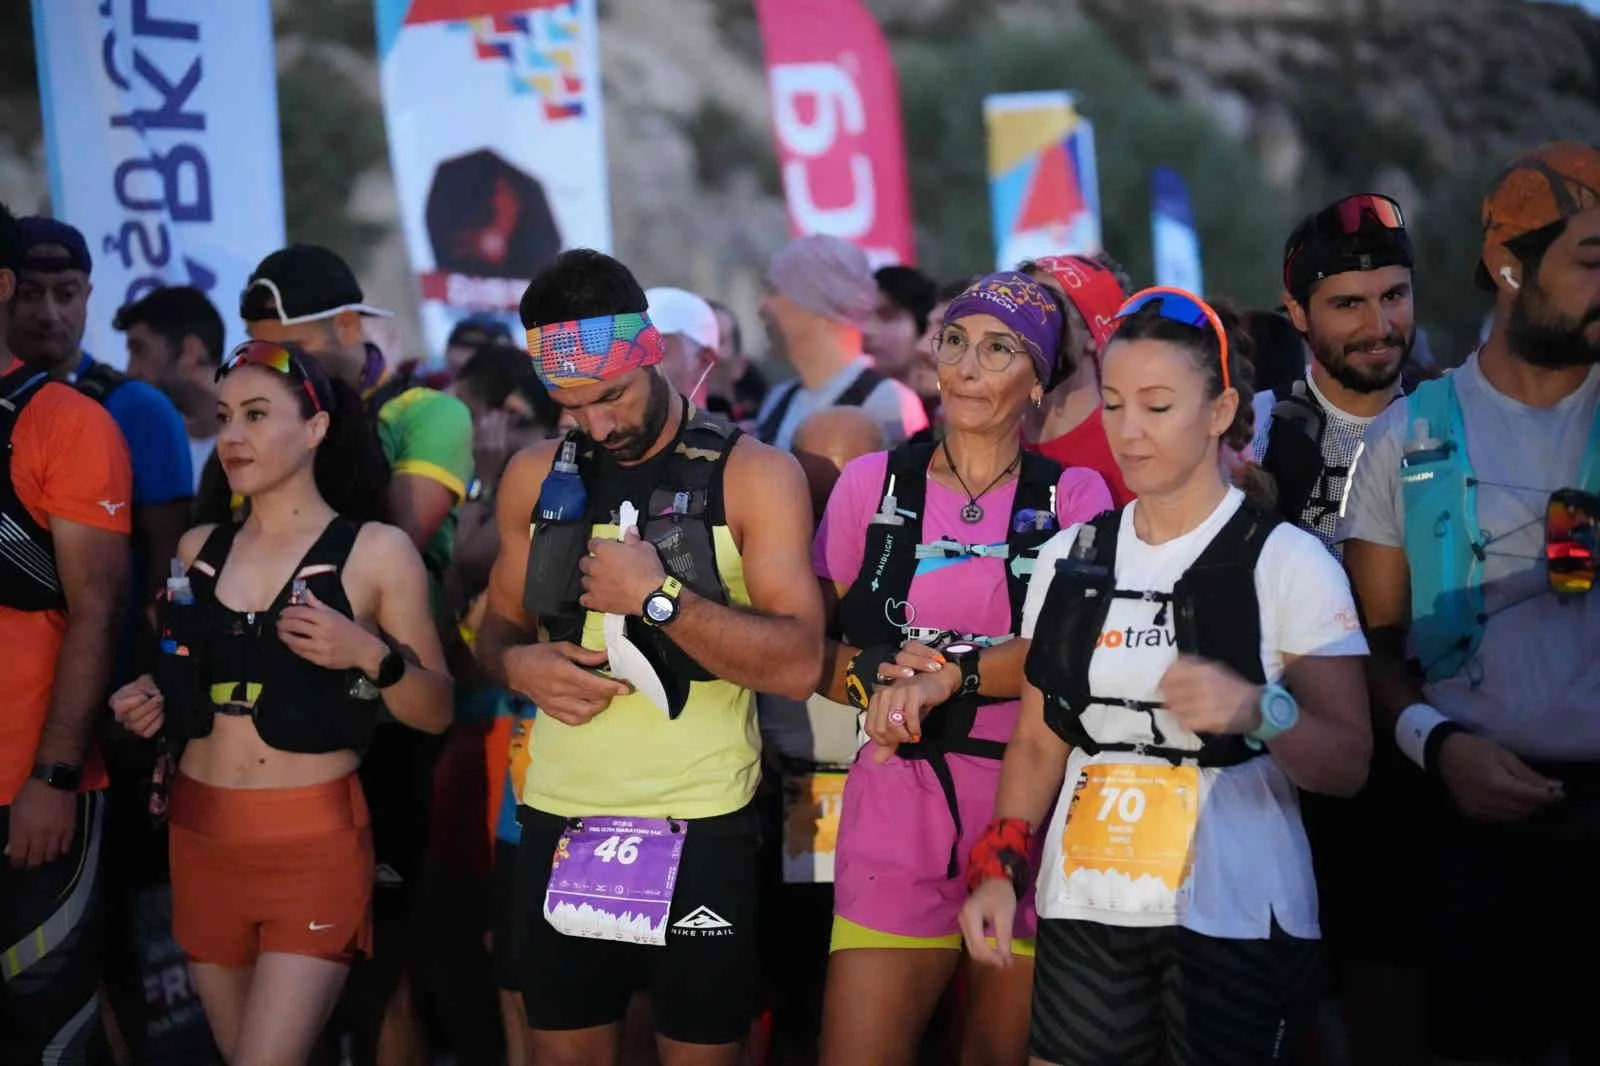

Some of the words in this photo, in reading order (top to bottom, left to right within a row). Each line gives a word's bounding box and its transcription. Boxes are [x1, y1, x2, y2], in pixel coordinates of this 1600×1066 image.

[1096, 787, 1145, 823] 70
[594, 835, 643, 864] 46
[702, 928, 734, 937] TRAIL
